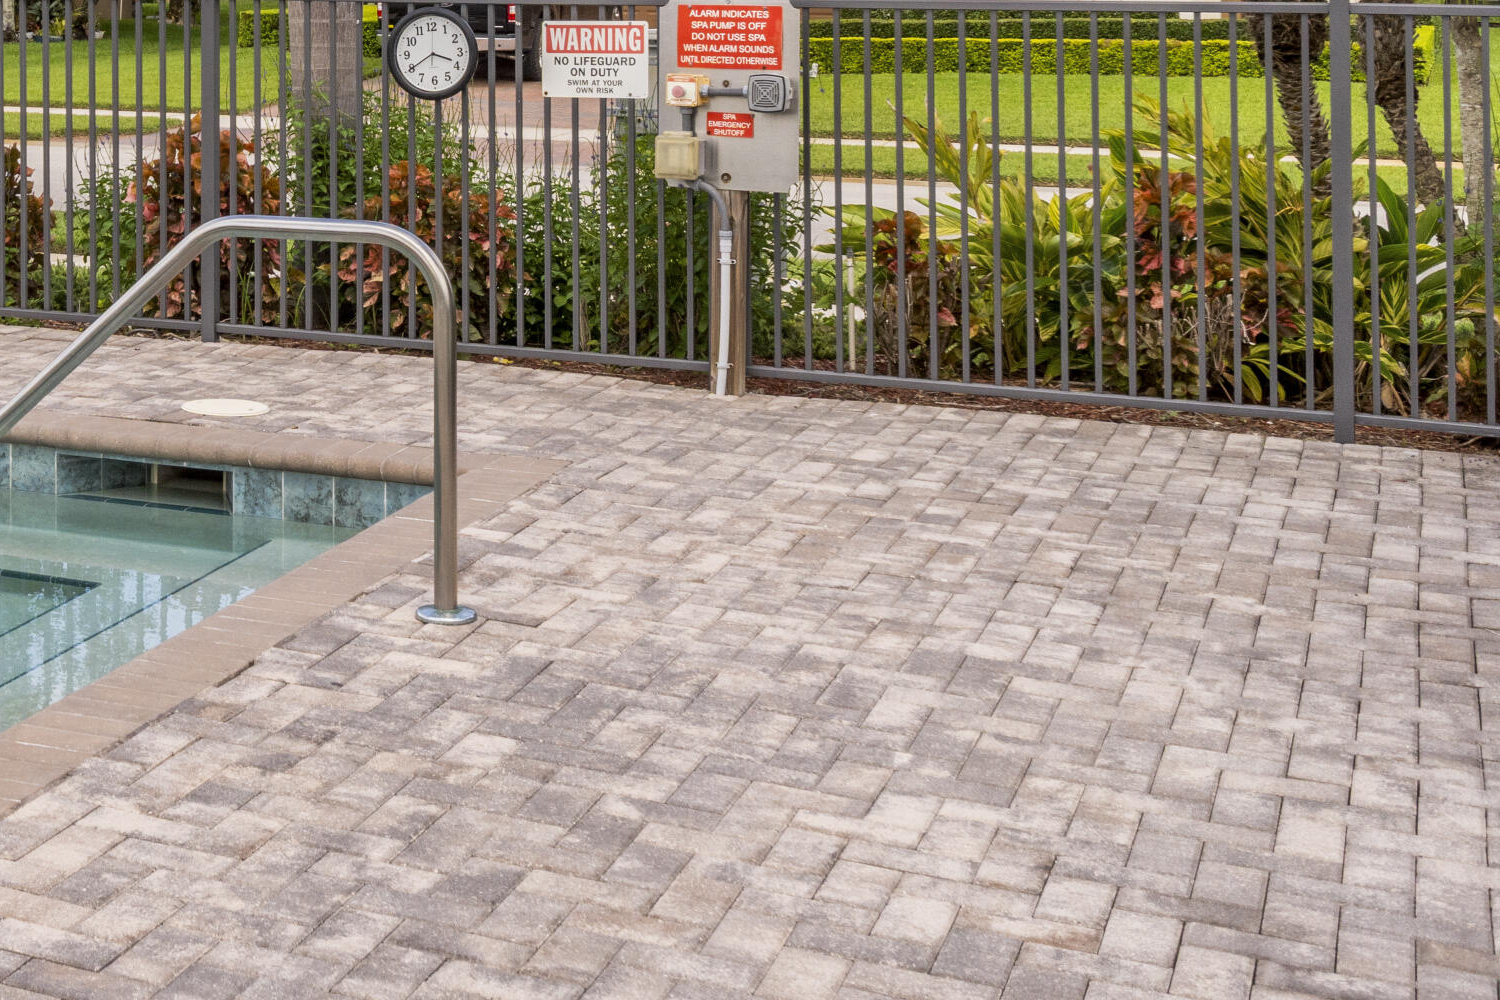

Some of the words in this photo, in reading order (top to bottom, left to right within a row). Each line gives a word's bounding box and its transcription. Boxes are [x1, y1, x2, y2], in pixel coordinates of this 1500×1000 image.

[689, 10, 719, 18] ALARM
[722, 10, 769, 19] INDICATES
[426, 22, 437, 32] 12
[443, 24, 448, 34] 1
[691, 21, 708, 29] SPA
[710, 21, 735, 29] PUMP
[737, 22, 746, 30] IS
[748, 22, 767, 30] OFF
[416, 26, 423, 36] 11
[406, 36, 417, 47] 10
[451, 33, 459, 43] 2
[550, 27, 641, 51] WARNING
[707, 33, 725, 41] NOT
[727, 33, 746, 41] USE
[748, 34, 766, 42] SPA
[457, 47, 463, 57] 3
[683, 44, 707, 52] WHEN
[709, 44, 737, 53] ALARM
[739, 45, 774, 54] SOUNDS
[404, 50, 410, 60] 9
[680, 55, 700, 63] UNTIL
[701, 56, 735, 64] DIRECTED
[736, 56, 778, 65] OTHERWISE
[453, 61, 460, 71] 4
[554, 57, 569, 66] NO
[573, 56, 636, 66] LIFEGUARD
[408, 63, 415, 73] 8
[570, 68, 586, 77] ON
[590, 67, 619, 77] DUTY
[418, 73, 425, 83] 7
[432, 76, 438, 85] 6
[444, 72, 451, 82] 5
[708, 120, 751, 128] EMERGENCY
